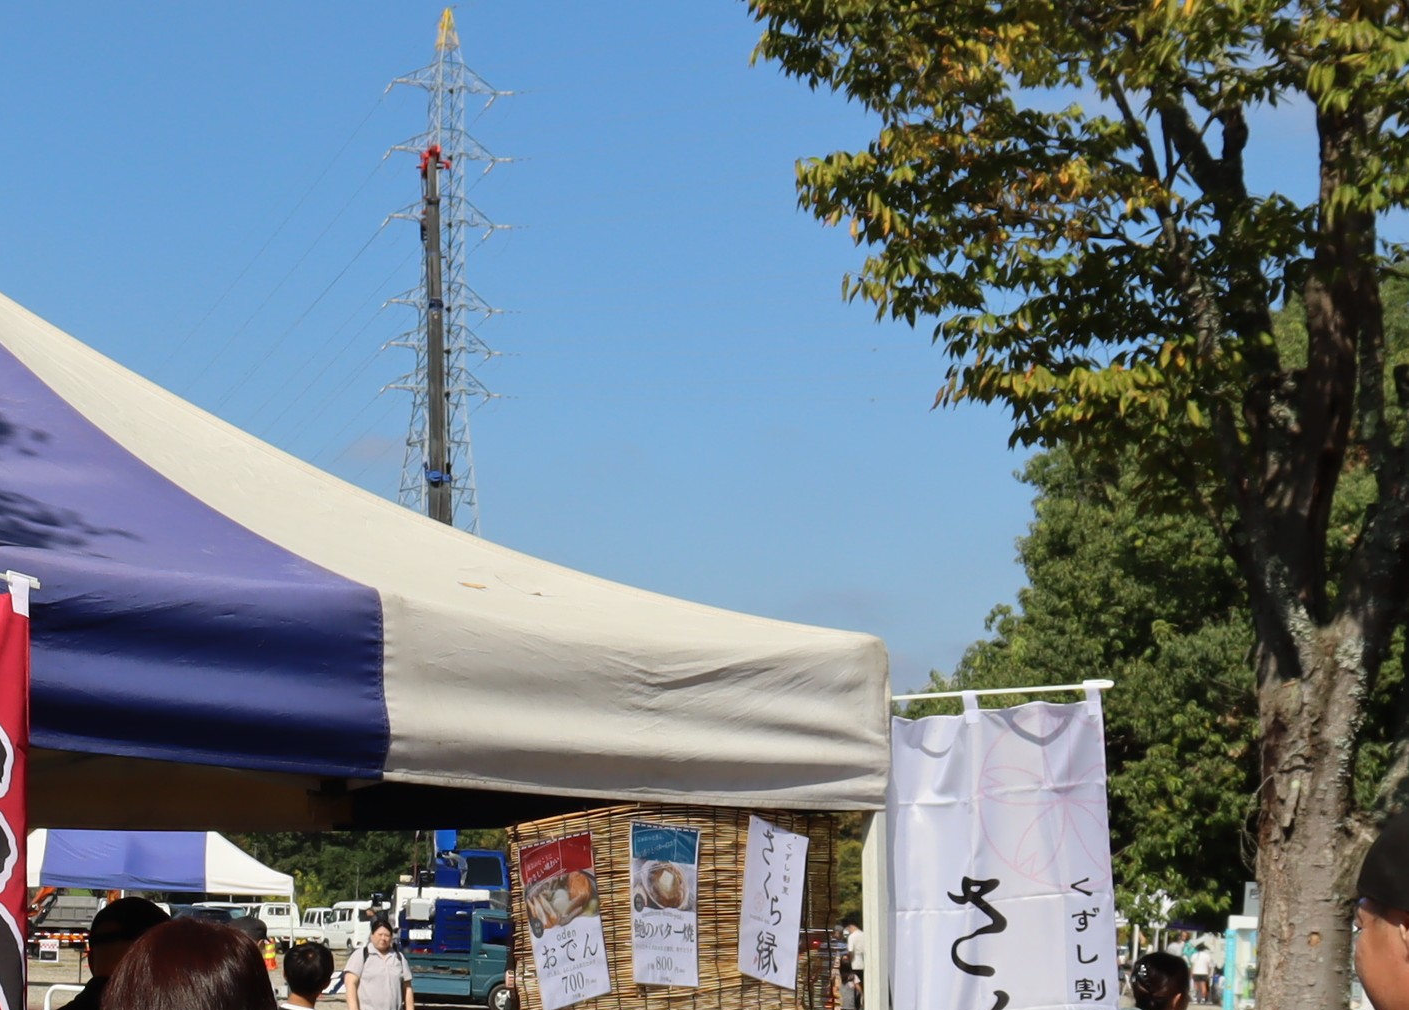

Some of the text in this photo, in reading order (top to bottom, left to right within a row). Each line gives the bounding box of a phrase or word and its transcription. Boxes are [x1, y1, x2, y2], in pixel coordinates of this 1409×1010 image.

[756, 829, 782, 976] さくら縁
[557, 928, 577, 941] oden
[542, 933, 598, 970] おでん
[655, 955, 673, 971] 800
[561, 971, 585, 995] 700
